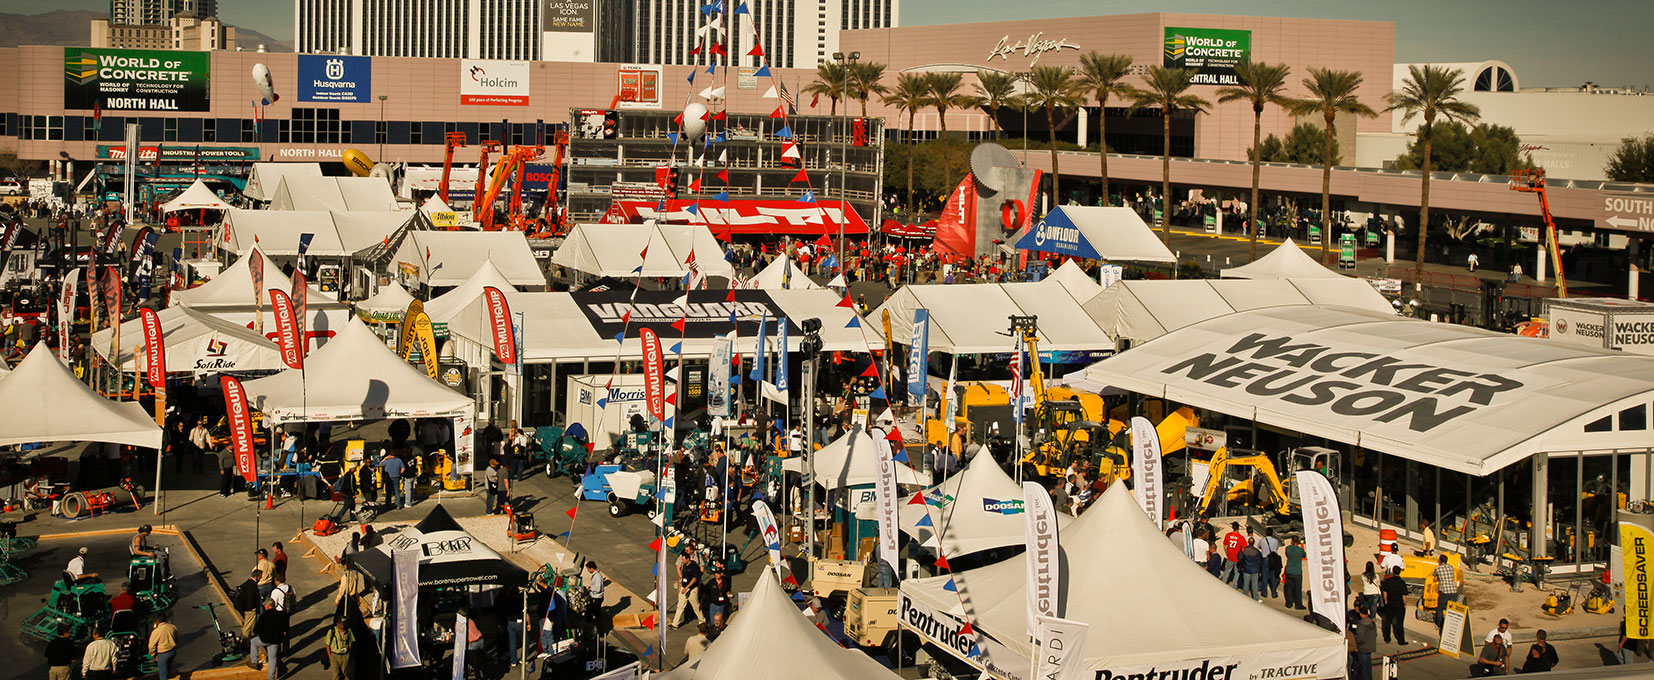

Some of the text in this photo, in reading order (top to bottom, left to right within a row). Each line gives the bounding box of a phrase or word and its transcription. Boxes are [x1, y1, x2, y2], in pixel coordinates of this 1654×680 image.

[1185, 36, 1223, 47] WORLD
[987, 31, 1080, 68] Las Vegas
[1185, 46, 1242, 57] CONCRETE
[99, 55, 182, 69] WORLD OF
[99, 68, 189, 81] CONCRETE
[1219, 74, 1239, 84] HALL
[313, 80, 356, 89] Husqvarna
[480, 77, 518, 88] Holcim
[107, 97, 179, 110] NORTH HALL
[280, 148, 315, 157] NORTH
[526, 172, 558, 183] BOSC
[1604, 197, 1654, 215] SOUTH
[276, 292, 295, 349] MULTIQUIP
[489, 290, 509, 345] MULTIQUIP
[145, 311, 159, 367] MULTIQUIP
[644, 330, 663, 397] MULTIQUIP
[1225, 332, 1525, 406] WACKER
[1159, 352, 1478, 433] NEUSON
[227, 379, 249, 453] MULTIQUIP
[1229, 539, 1238, 548] 27
[1634, 536, 1649, 638] SCREEDSAVER
[1260, 663, 1318, 679] TRACTIVE
